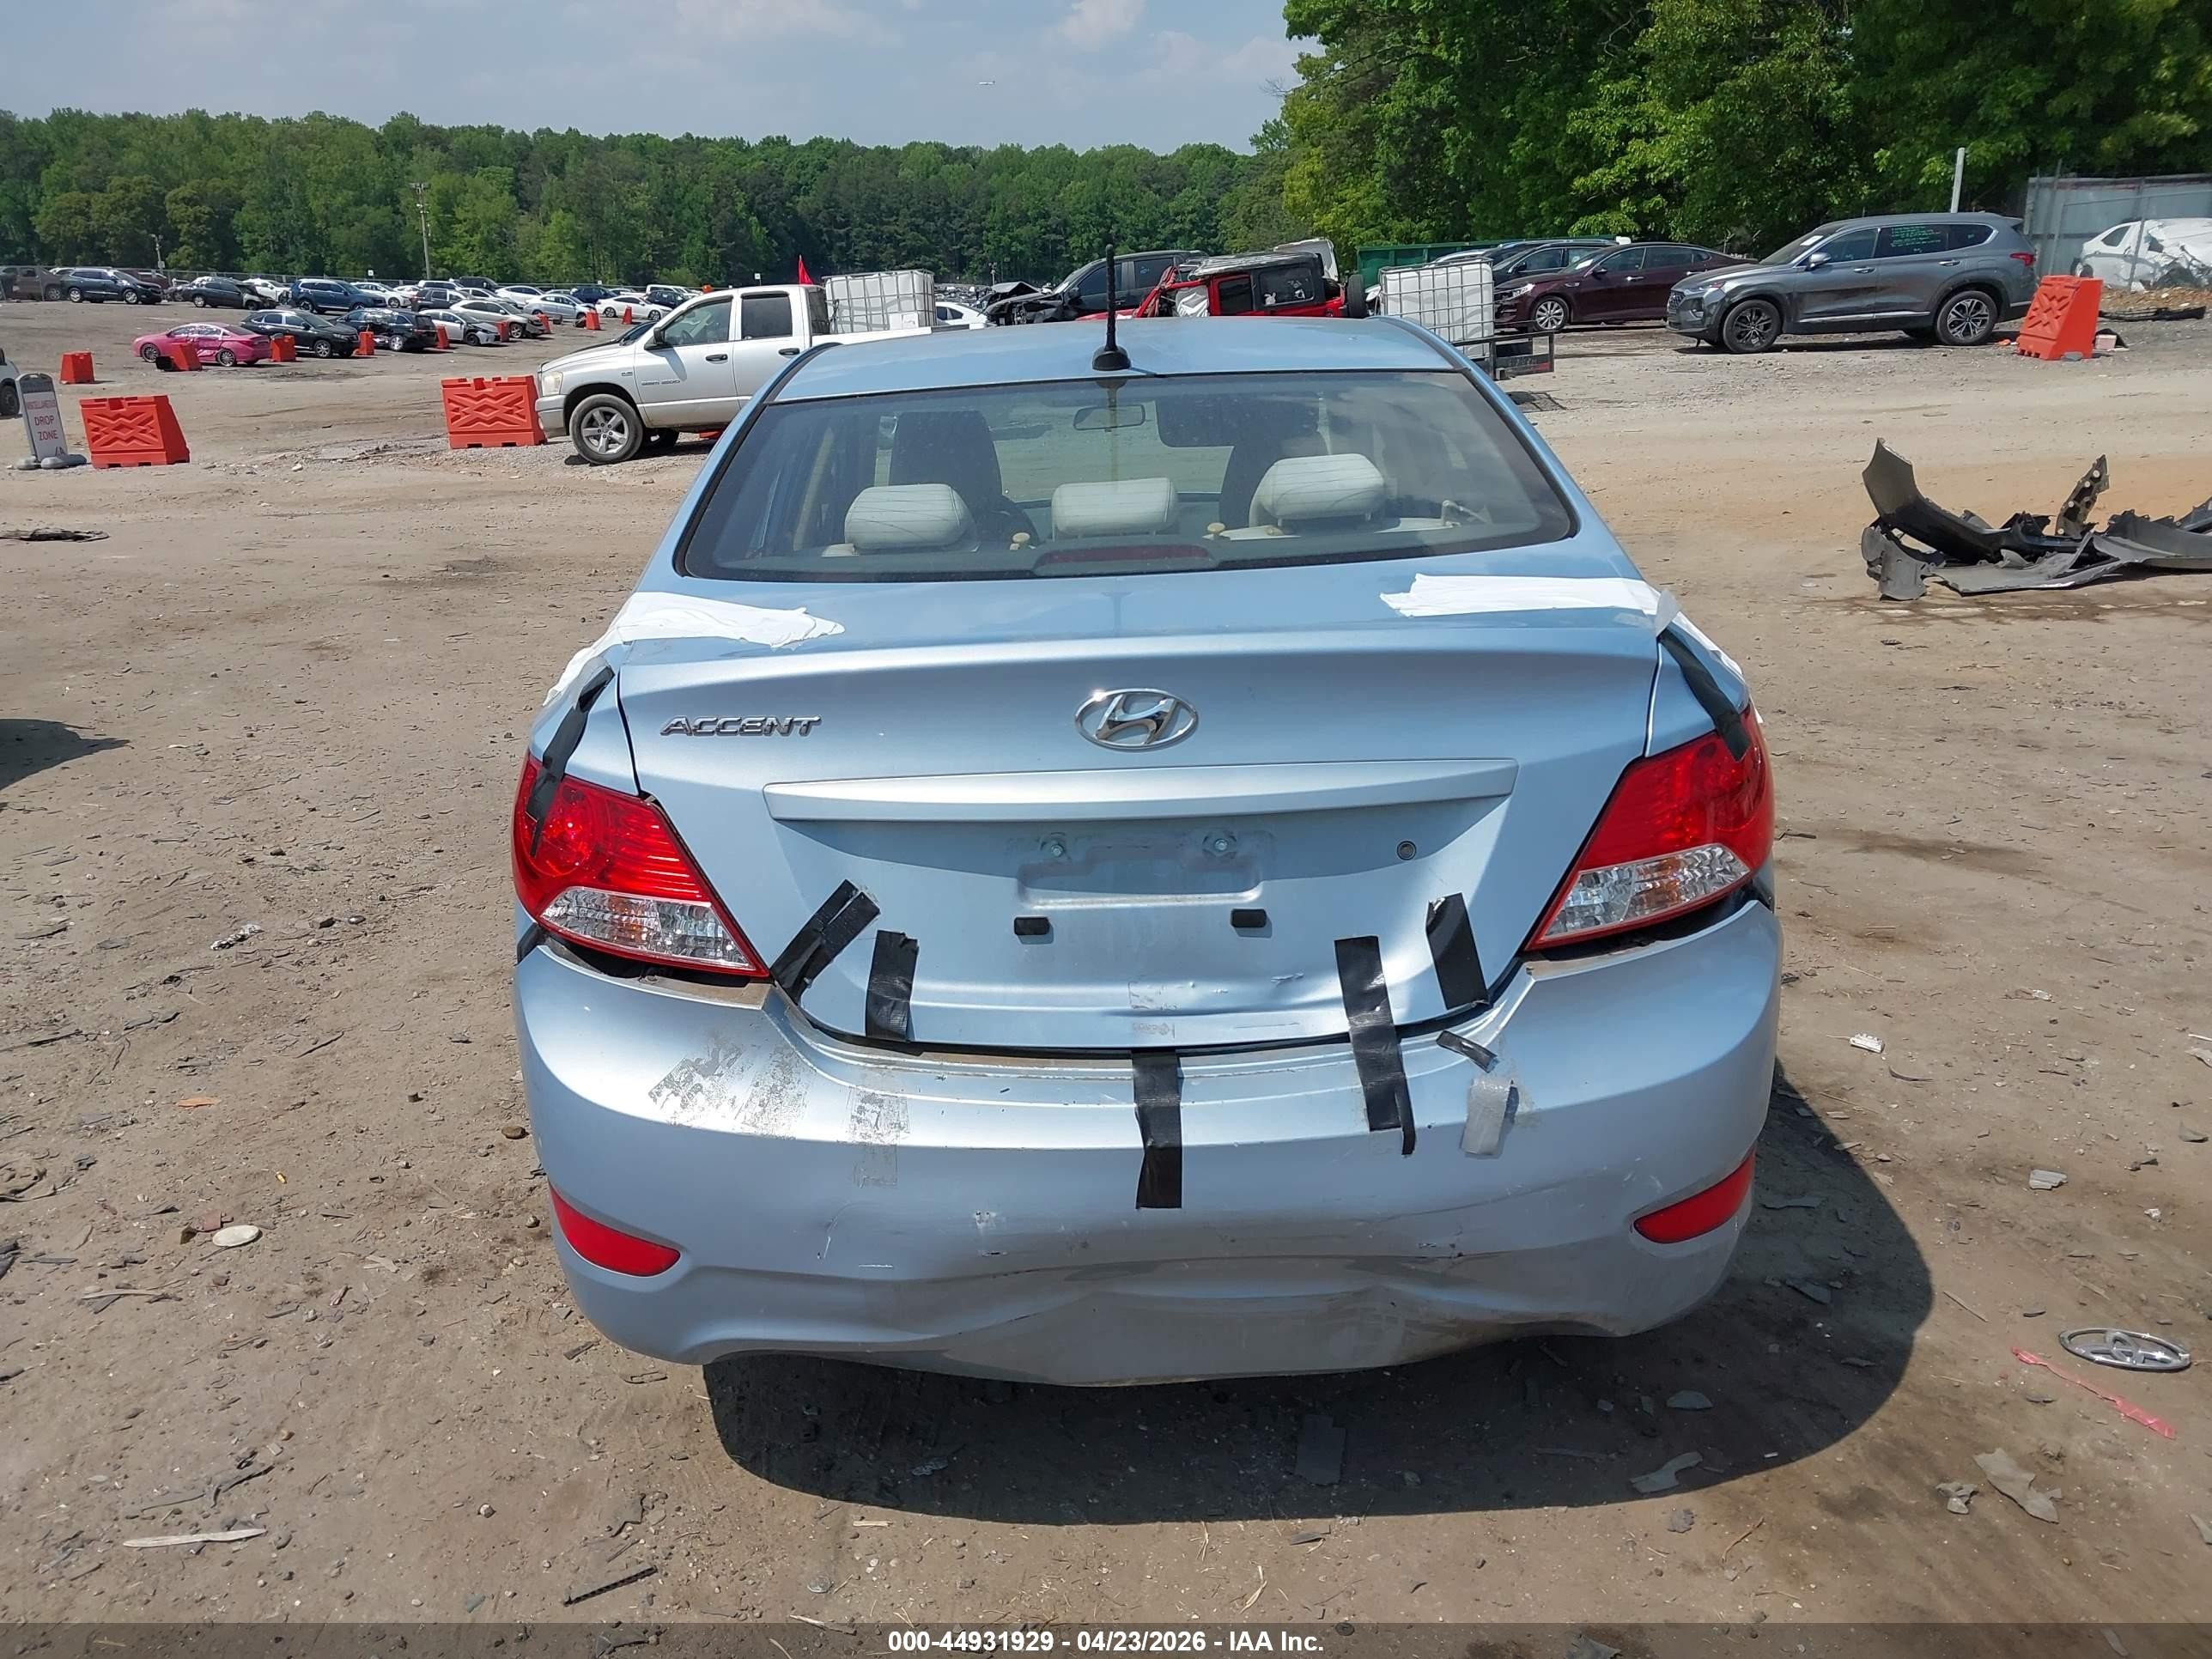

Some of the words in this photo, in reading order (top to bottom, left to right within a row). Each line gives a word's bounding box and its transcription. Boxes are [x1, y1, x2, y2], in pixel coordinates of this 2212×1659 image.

[34, 415, 55, 426] DROP
[38, 429, 58, 441] ZONE
[660, 716, 821, 736] ACCENT
